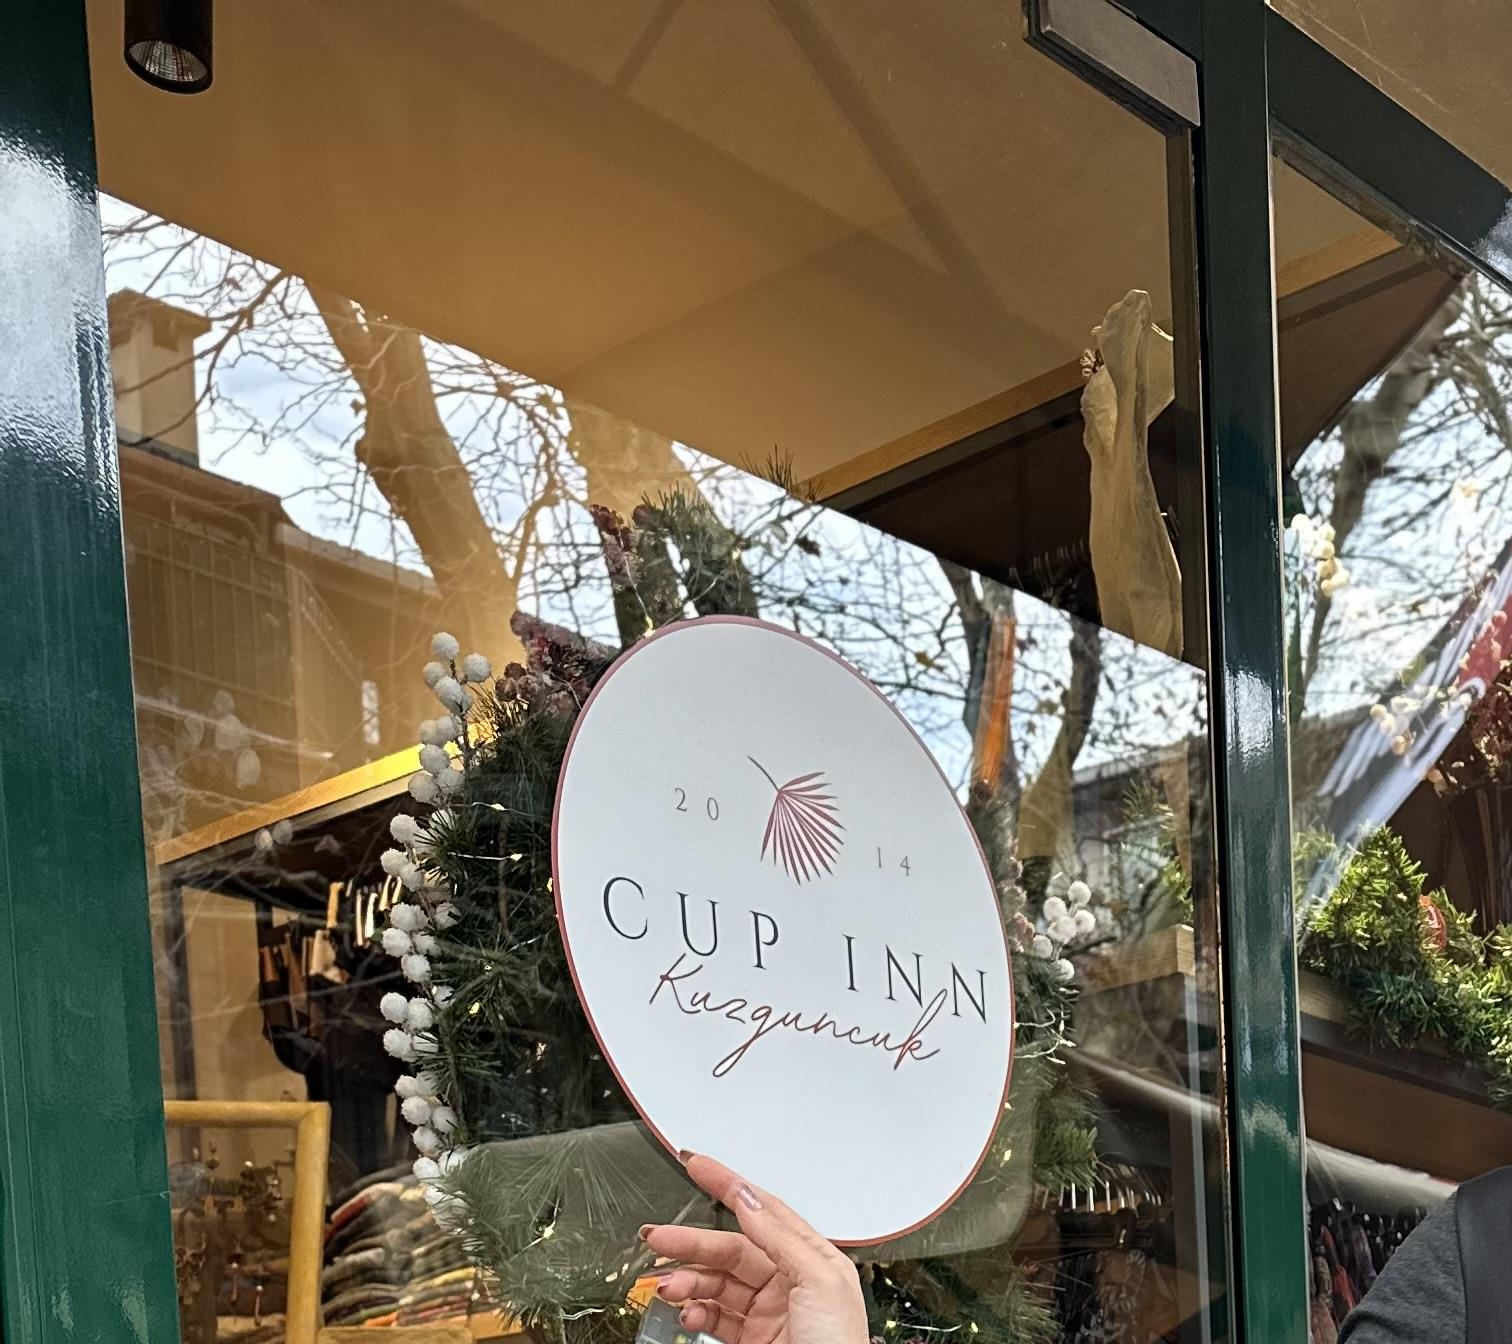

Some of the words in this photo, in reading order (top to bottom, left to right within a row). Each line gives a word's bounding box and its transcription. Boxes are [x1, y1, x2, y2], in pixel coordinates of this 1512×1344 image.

[674, 787, 720, 822] 20
[875, 845, 911, 877] 14
[602, 876, 779, 971] CUP
[842, 933, 988, 1025] INN
[648, 952, 948, 1078] Kuzguncuk
